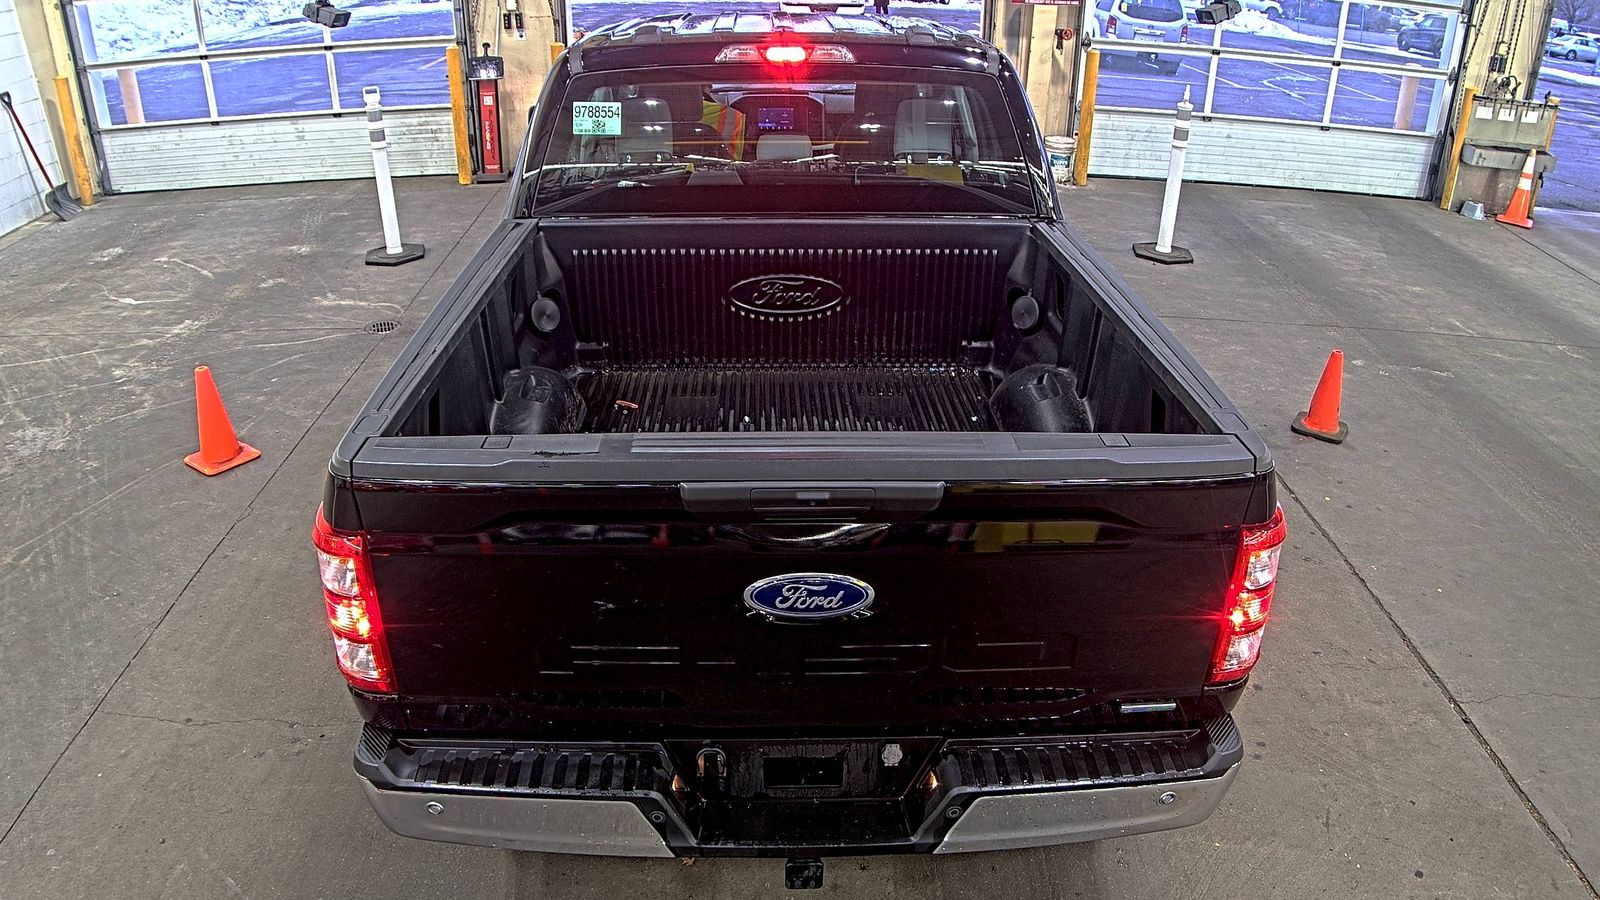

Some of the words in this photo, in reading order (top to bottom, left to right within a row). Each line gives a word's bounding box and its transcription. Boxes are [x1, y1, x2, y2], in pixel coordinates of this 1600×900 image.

[574, 105, 620, 119] 9788554
[752, 279, 822, 306] Ford
[775, 583, 845, 609] Ford
